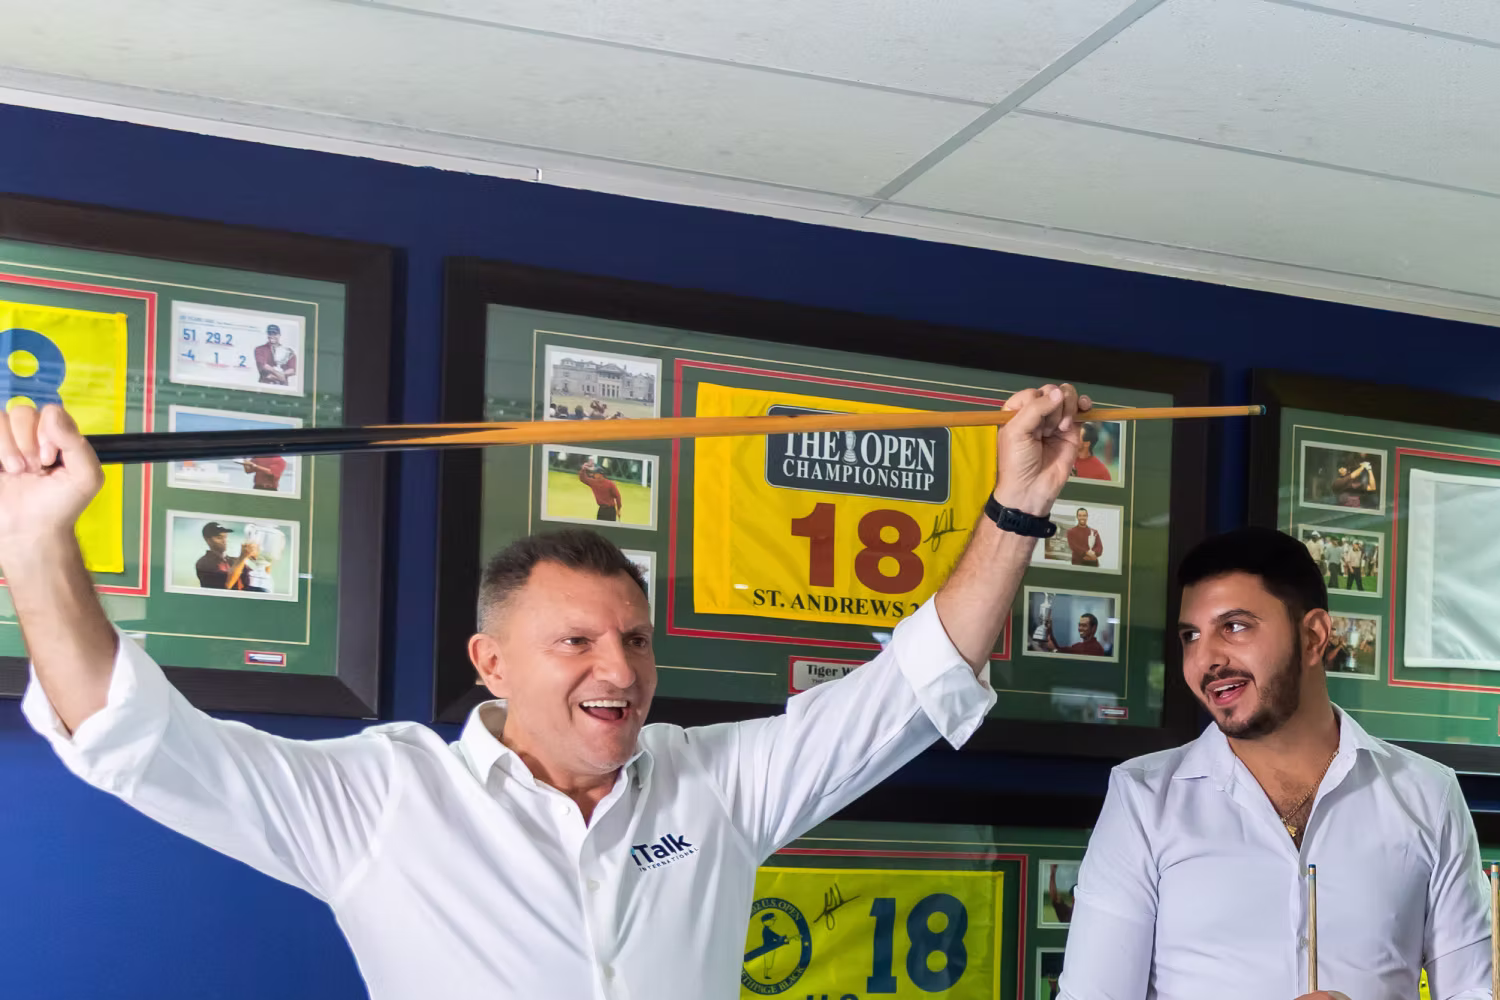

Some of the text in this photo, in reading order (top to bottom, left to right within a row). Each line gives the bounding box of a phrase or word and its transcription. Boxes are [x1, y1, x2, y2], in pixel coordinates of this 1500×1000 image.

[183, 328, 233, 346] 51 29.2
[785, 431, 936, 472] THE OPEN
[782, 459, 935, 491] CHAMPIONSHIP
[791, 502, 925, 594] 18
[753, 589, 786, 608] ST.
[790, 593, 905, 618] ANDREWS
[806, 664, 838, 677] Tiger
[630, 833, 693, 866] iTalk
[639, 847, 699, 872] INTERNATIONAL
[866, 893, 968, 994] 18
